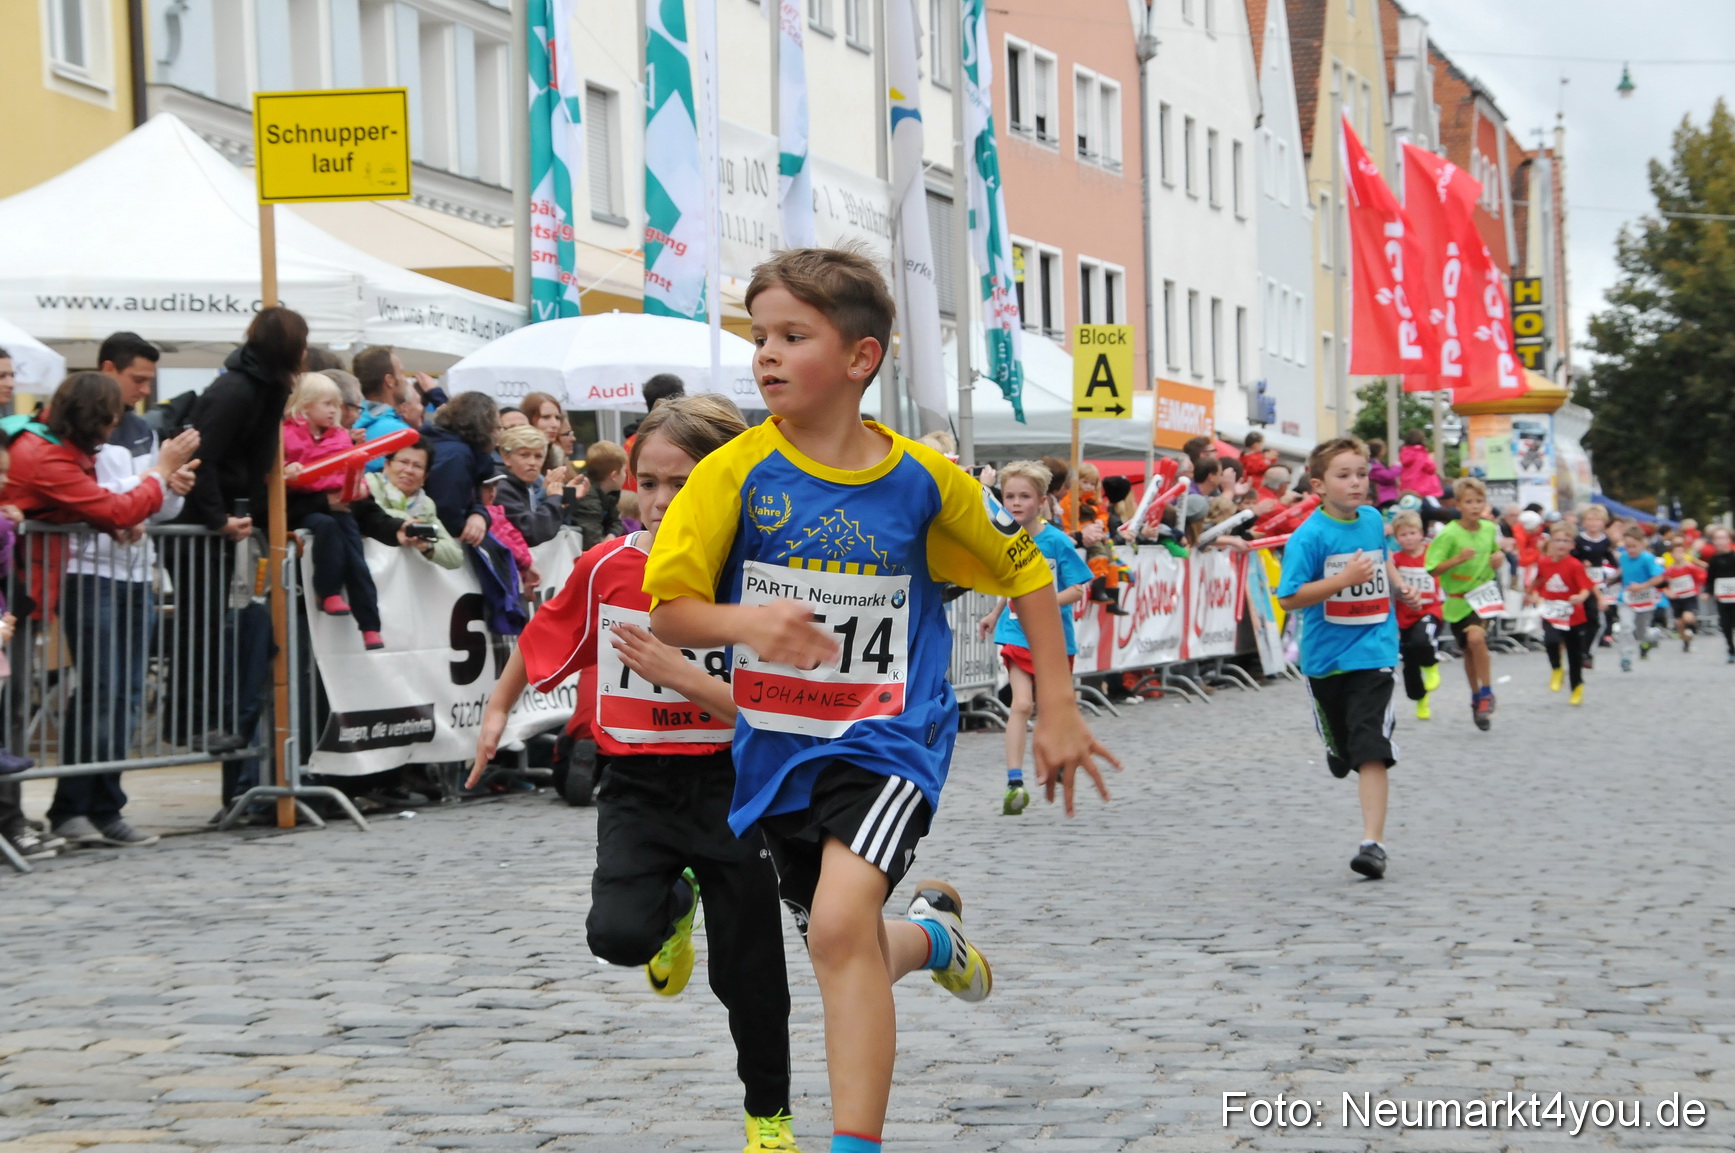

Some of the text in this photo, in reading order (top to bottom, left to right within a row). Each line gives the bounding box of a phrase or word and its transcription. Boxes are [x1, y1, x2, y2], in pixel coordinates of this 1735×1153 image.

[266, 123, 397, 147] Schnupper-
[312, 152, 354, 174] lauf
[470, 315, 493, 340] Audi
[1079, 328, 1127, 345] Block
[1085, 353, 1119, 397] A
[587, 384, 635, 399] Audi
[761, 495, 774, 504] 15
[746, 576, 886, 607] PARTL Neumarkt
[750, 680, 862, 707] JOHANNES
[652, 708, 694, 726] Max
